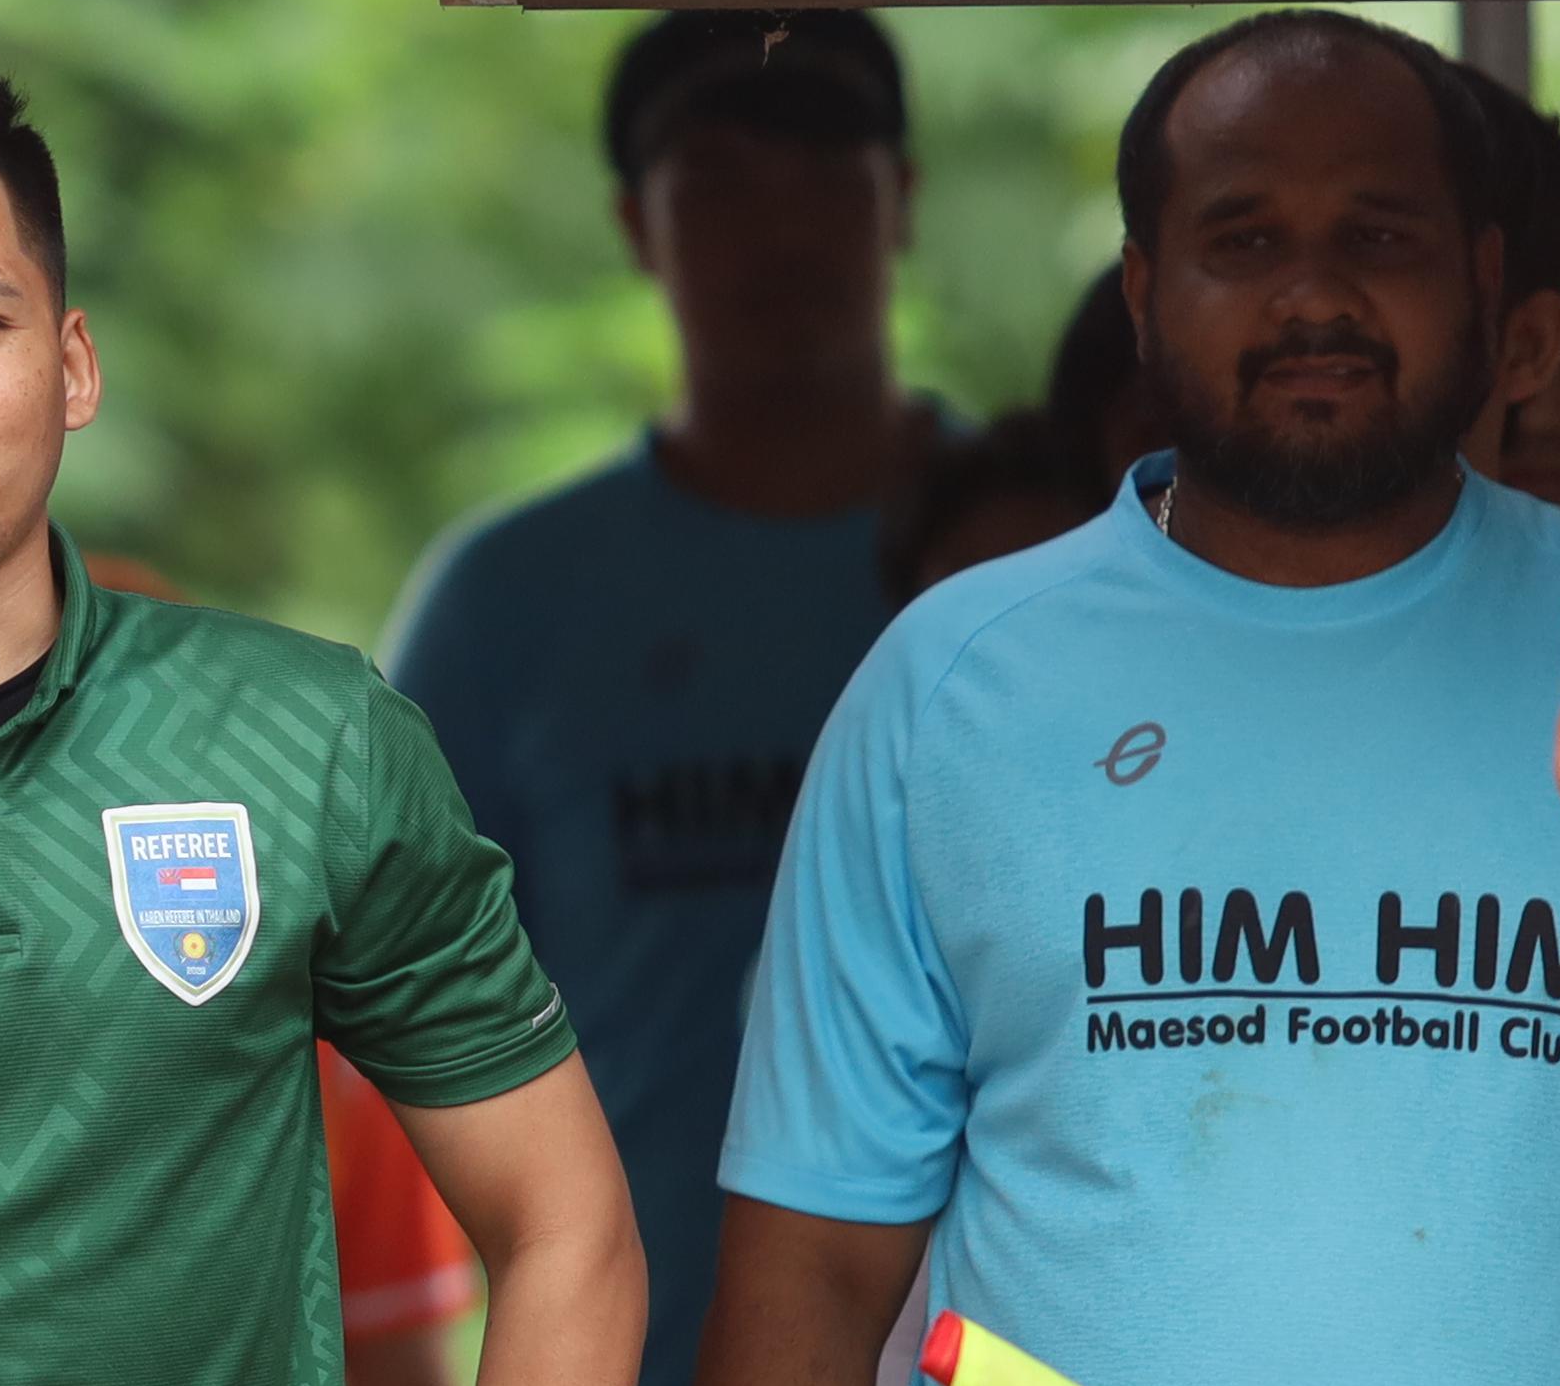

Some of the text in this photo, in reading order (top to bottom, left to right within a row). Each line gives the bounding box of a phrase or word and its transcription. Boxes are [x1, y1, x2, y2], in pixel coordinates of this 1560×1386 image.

[131, 832, 232, 861] REFEREE
[1083, 887, 1321, 988] HIM
[1086, 1005, 1266, 1054] Maesod
[1288, 1006, 1479, 1053] Football
